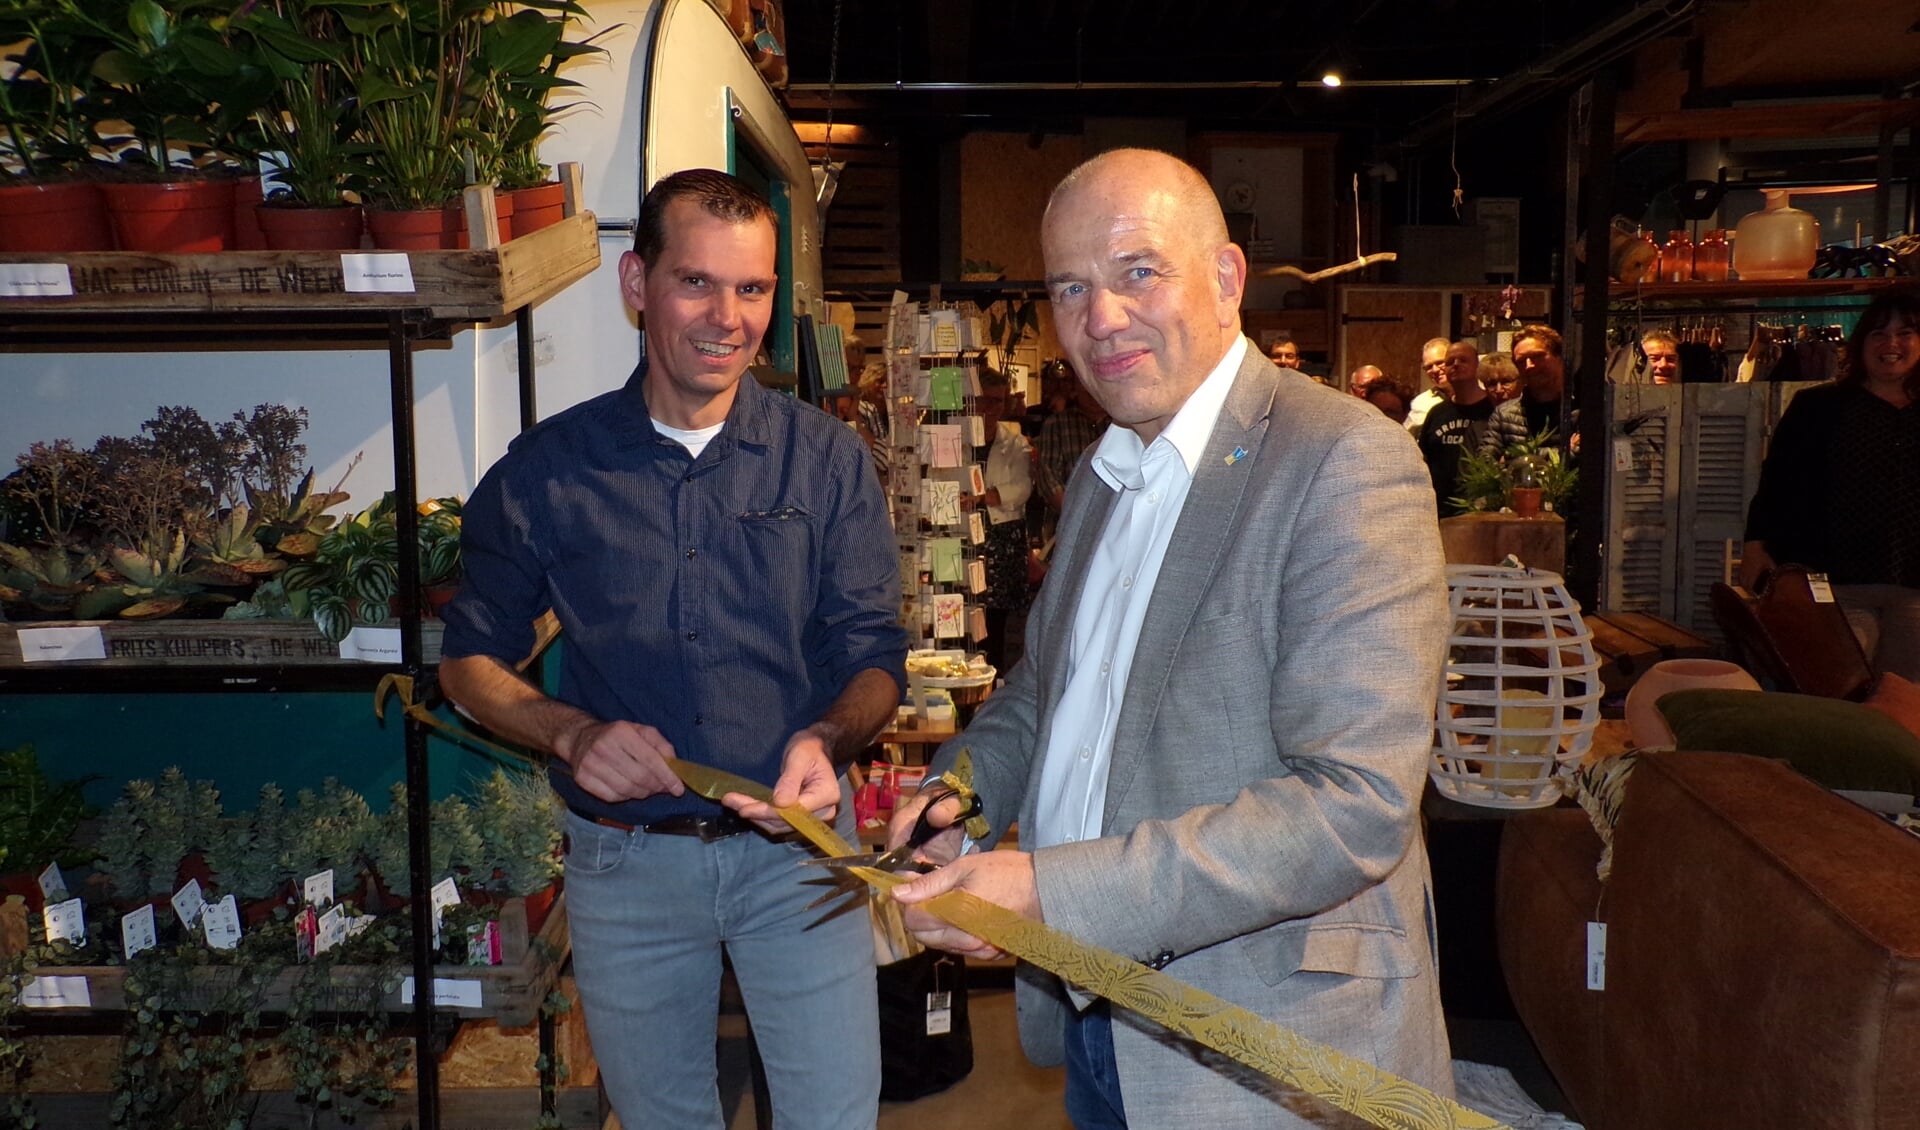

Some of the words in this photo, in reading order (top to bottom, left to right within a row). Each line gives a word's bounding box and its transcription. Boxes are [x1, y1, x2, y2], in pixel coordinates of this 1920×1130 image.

[238, 266, 271, 294] DE
[110, 638, 157, 658] FRITS
[270, 638, 294, 657] DE
